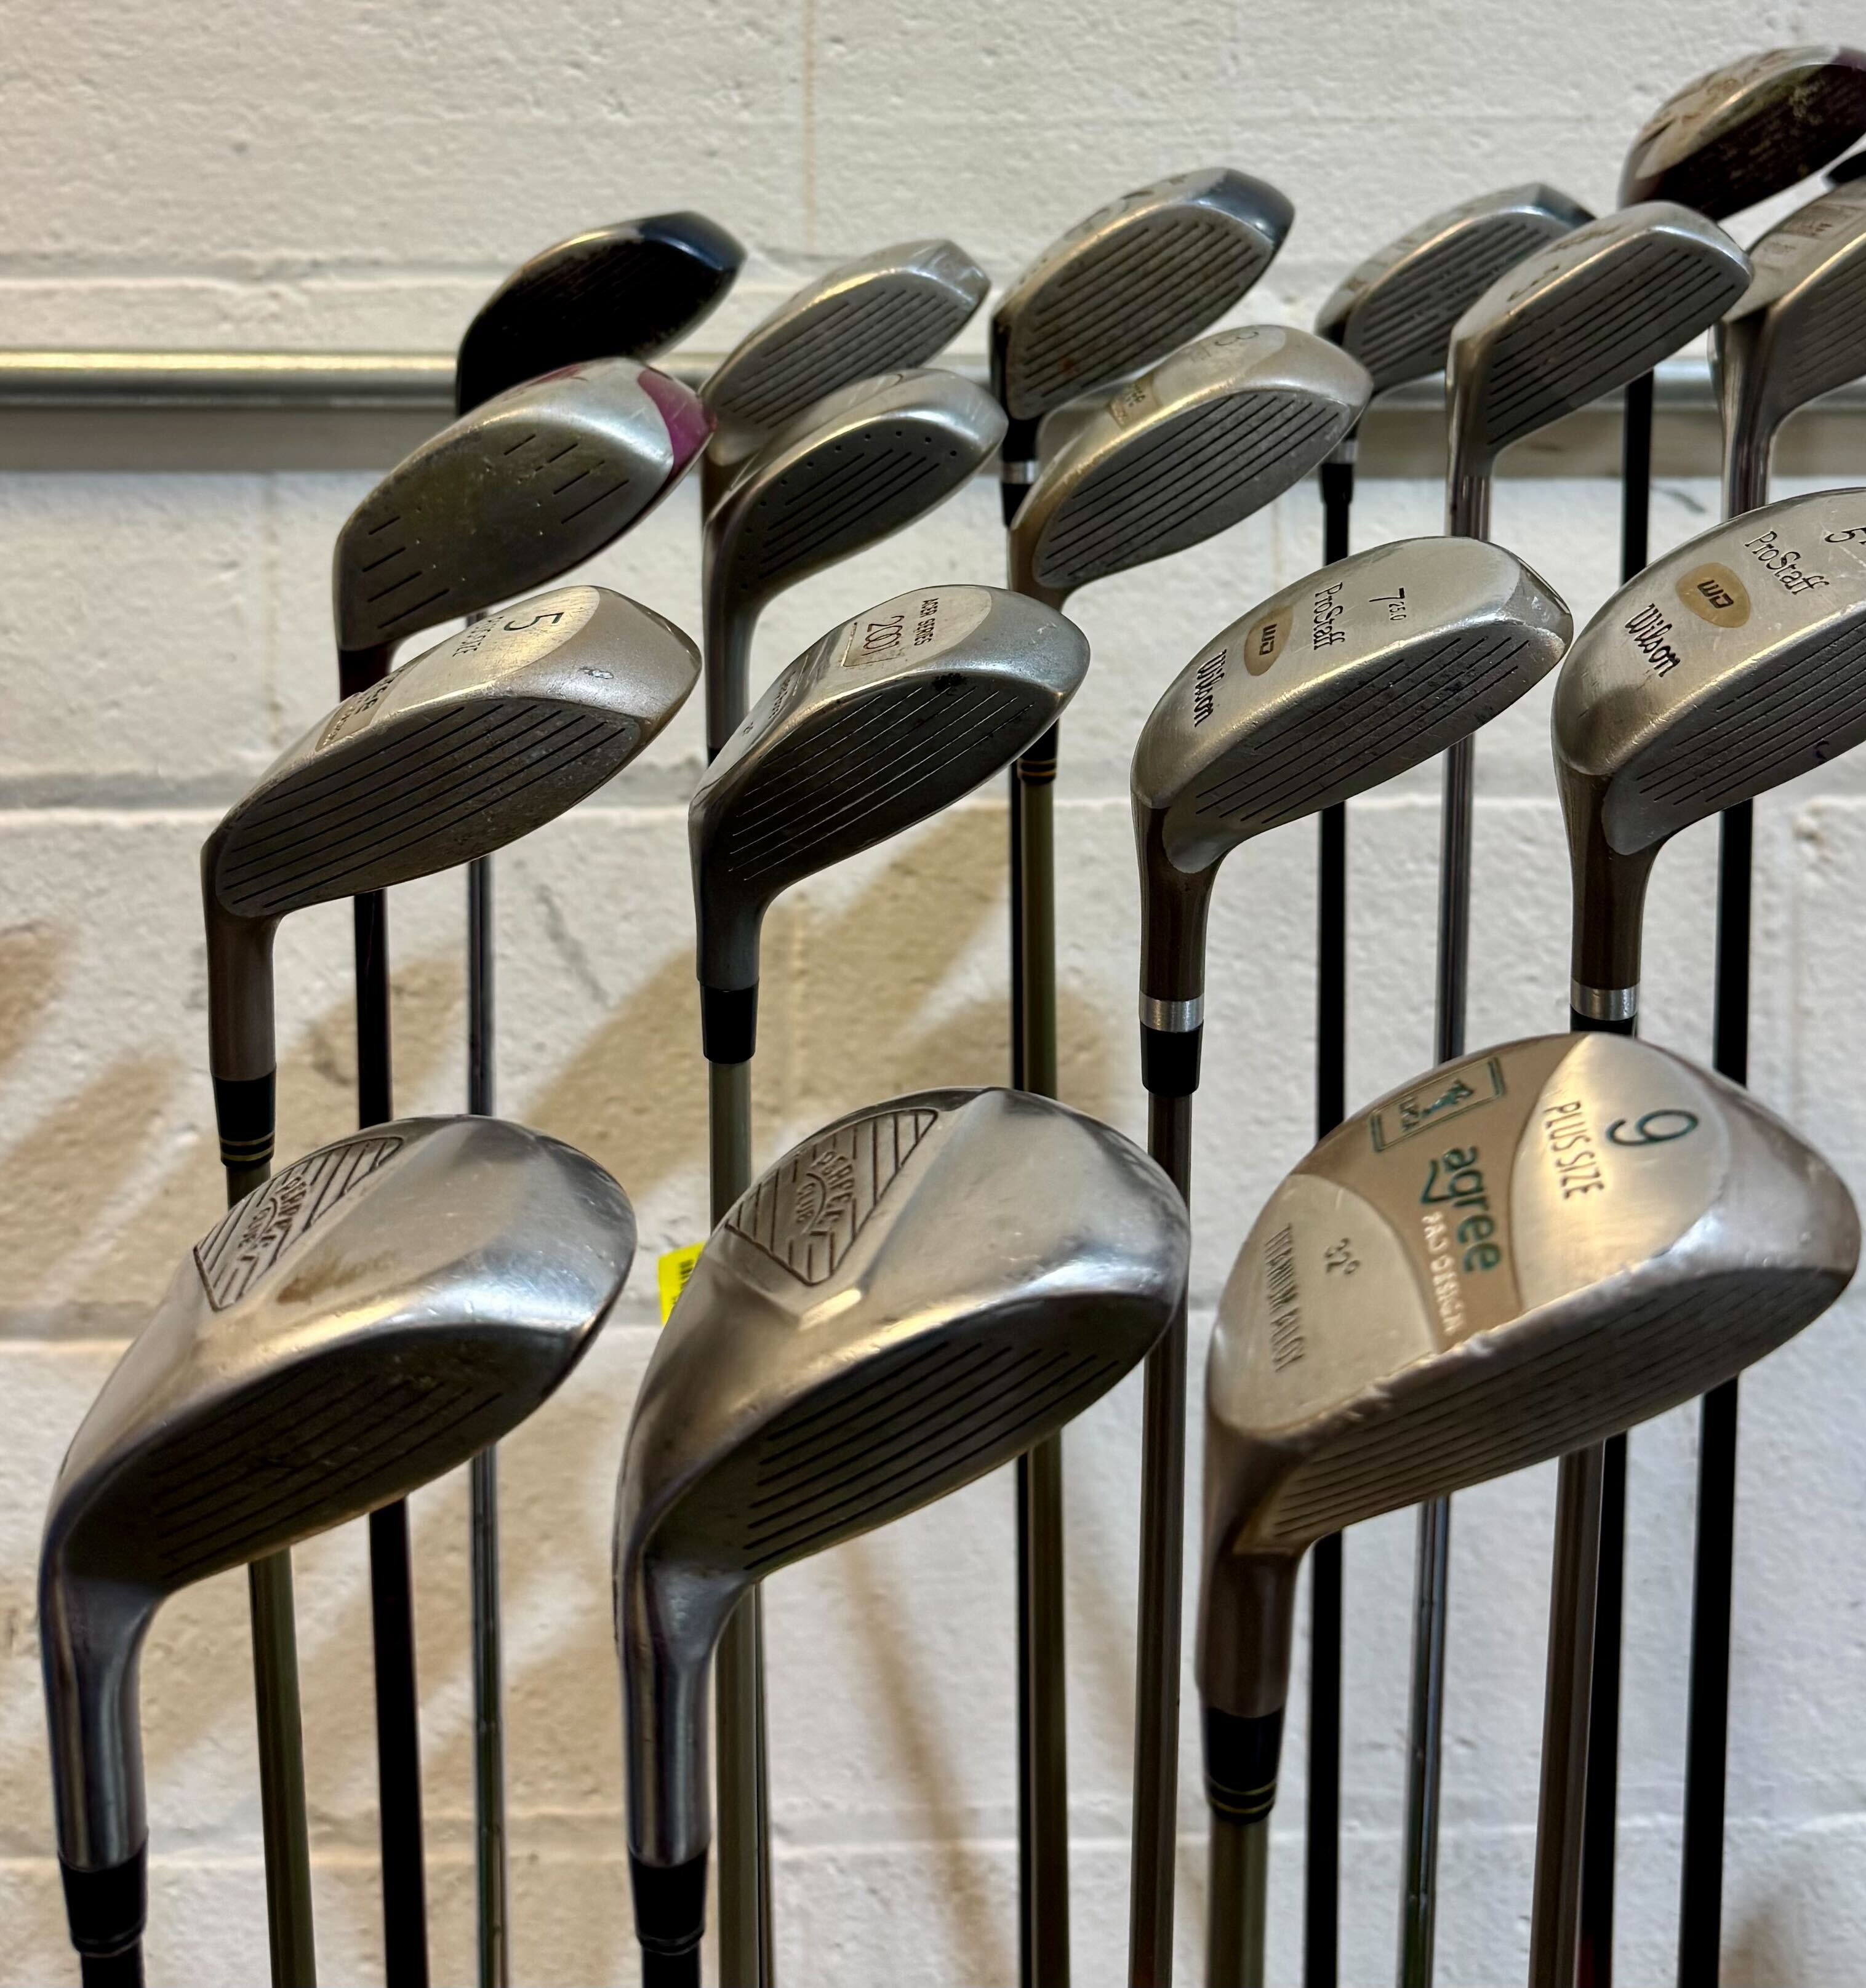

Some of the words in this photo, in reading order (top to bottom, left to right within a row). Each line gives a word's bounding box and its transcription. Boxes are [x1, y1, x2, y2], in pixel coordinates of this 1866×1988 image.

[1745, 530, 1830, 596] ProStaff
[503, 611, 564, 632] 5
[914, 618, 935, 646] SERIES
[921, 598, 939, 618] ACER
[1313, 581, 1347, 650] ProStaff
[1369, 588, 1405, 603] 7
[1388, 601, 1407, 621] 25.0
[1624, 603, 1681, 677] Wilson
[1193, 649, 1227, 728] Wilson
[1543, 1101, 1591, 1152] PLUS
[1606, 1109, 1699, 1146] 9
[1555, 1150, 1604, 1200] SIZE
[1420, 1146, 1502, 1274] agree
[1422, 1211, 1449, 1255] PRO
[1265, 1222, 1299, 1315] TITANIUM
[1430, 1254, 1466, 1337] DESIGN
[1270, 1307, 1305, 1373] ALLOY
